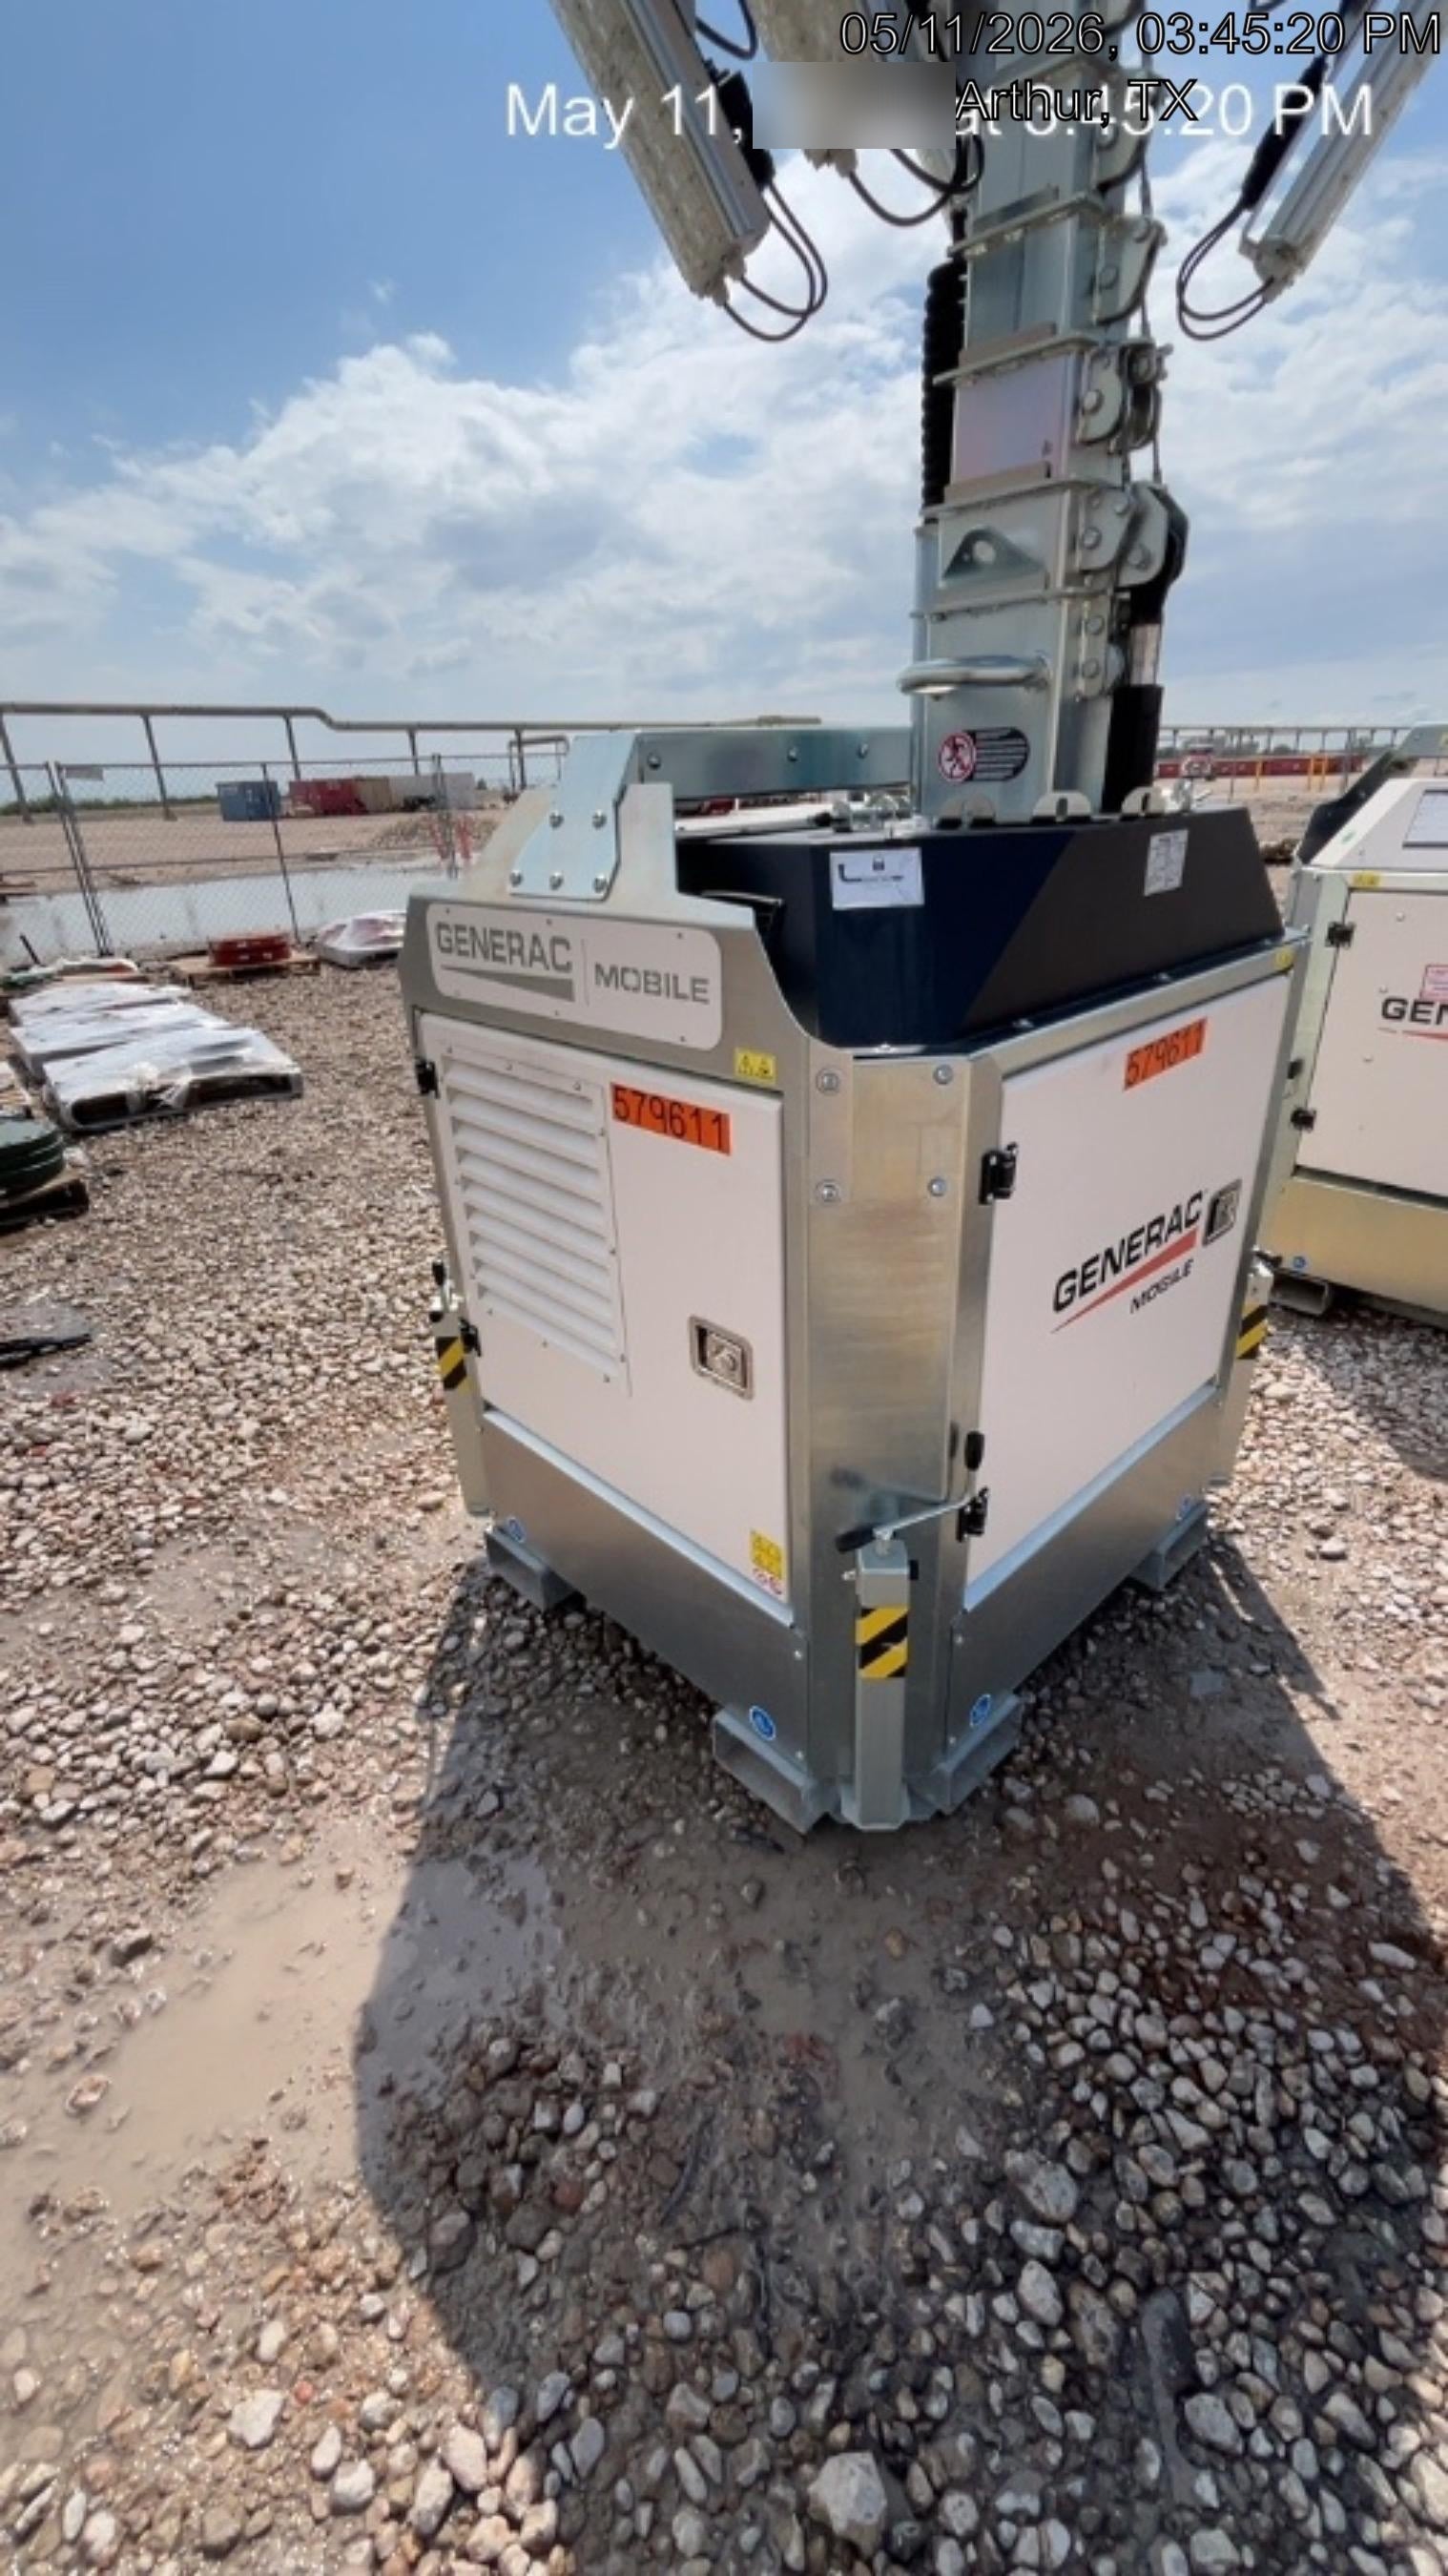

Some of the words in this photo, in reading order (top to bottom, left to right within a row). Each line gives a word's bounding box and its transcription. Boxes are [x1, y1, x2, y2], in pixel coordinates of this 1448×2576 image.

[435, 921, 572, 973] GENERAC
[594, 962, 711, 1006] MOBILE
[1126, 1018, 1206, 1089] 579611
[613, 1084, 724, 1153] 579611
[1052, 1189, 1204, 1314] GENERAC
[1129, 1257, 1195, 1315] MOBILE
